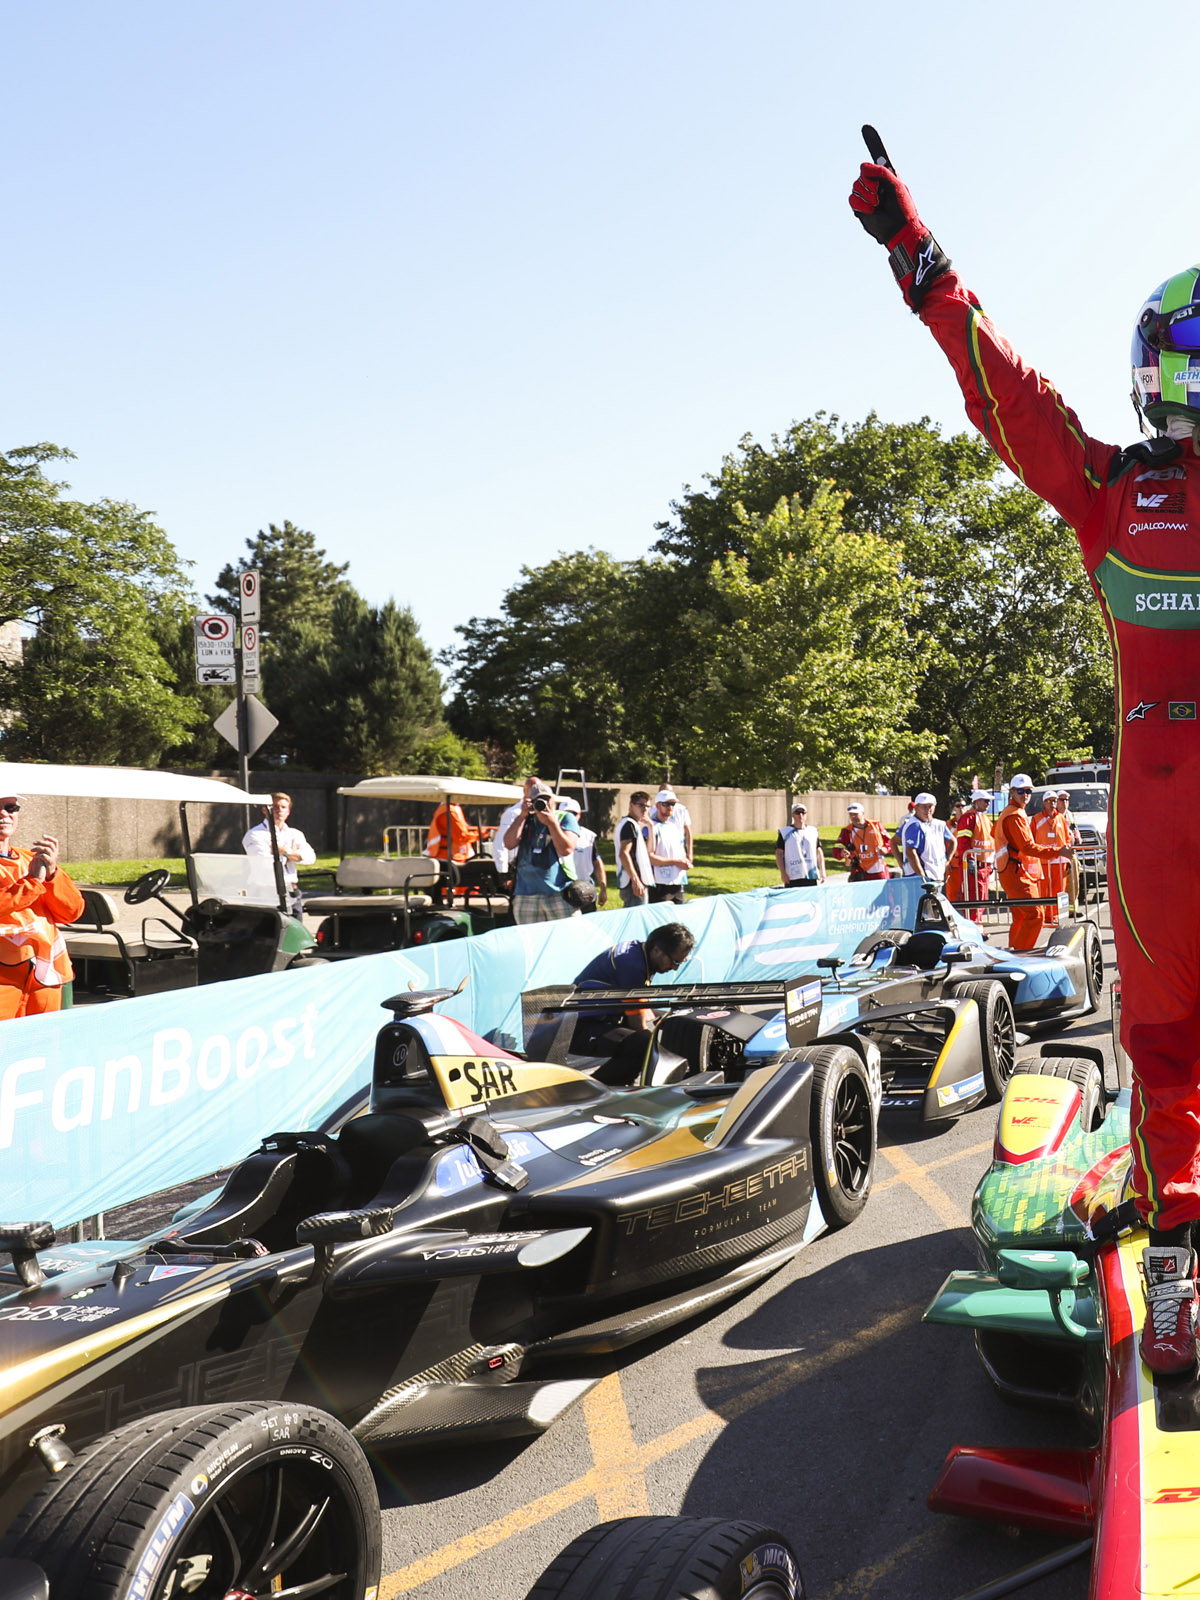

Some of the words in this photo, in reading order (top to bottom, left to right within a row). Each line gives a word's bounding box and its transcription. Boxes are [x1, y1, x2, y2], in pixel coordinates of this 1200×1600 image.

[1128, 521, 1188, 536] QUALCOMM
[0, 1002, 319, 1149] FanBoost
[463, 1061, 518, 1102] SAR
[1011, 1096, 1061, 1105] DHL
[616, 1147, 808, 1235] TECHEETAH
[758, 1198, 778, 1213] TEAM
[421, 1246, 490, 1261] SECA
[260, 1415, 279, 1432] SET
[272, 1427, 291, 1442] SAR
[206, 1442, 239, 1475] MICHELIN
[280, 1448, 307, 1456] RACING
